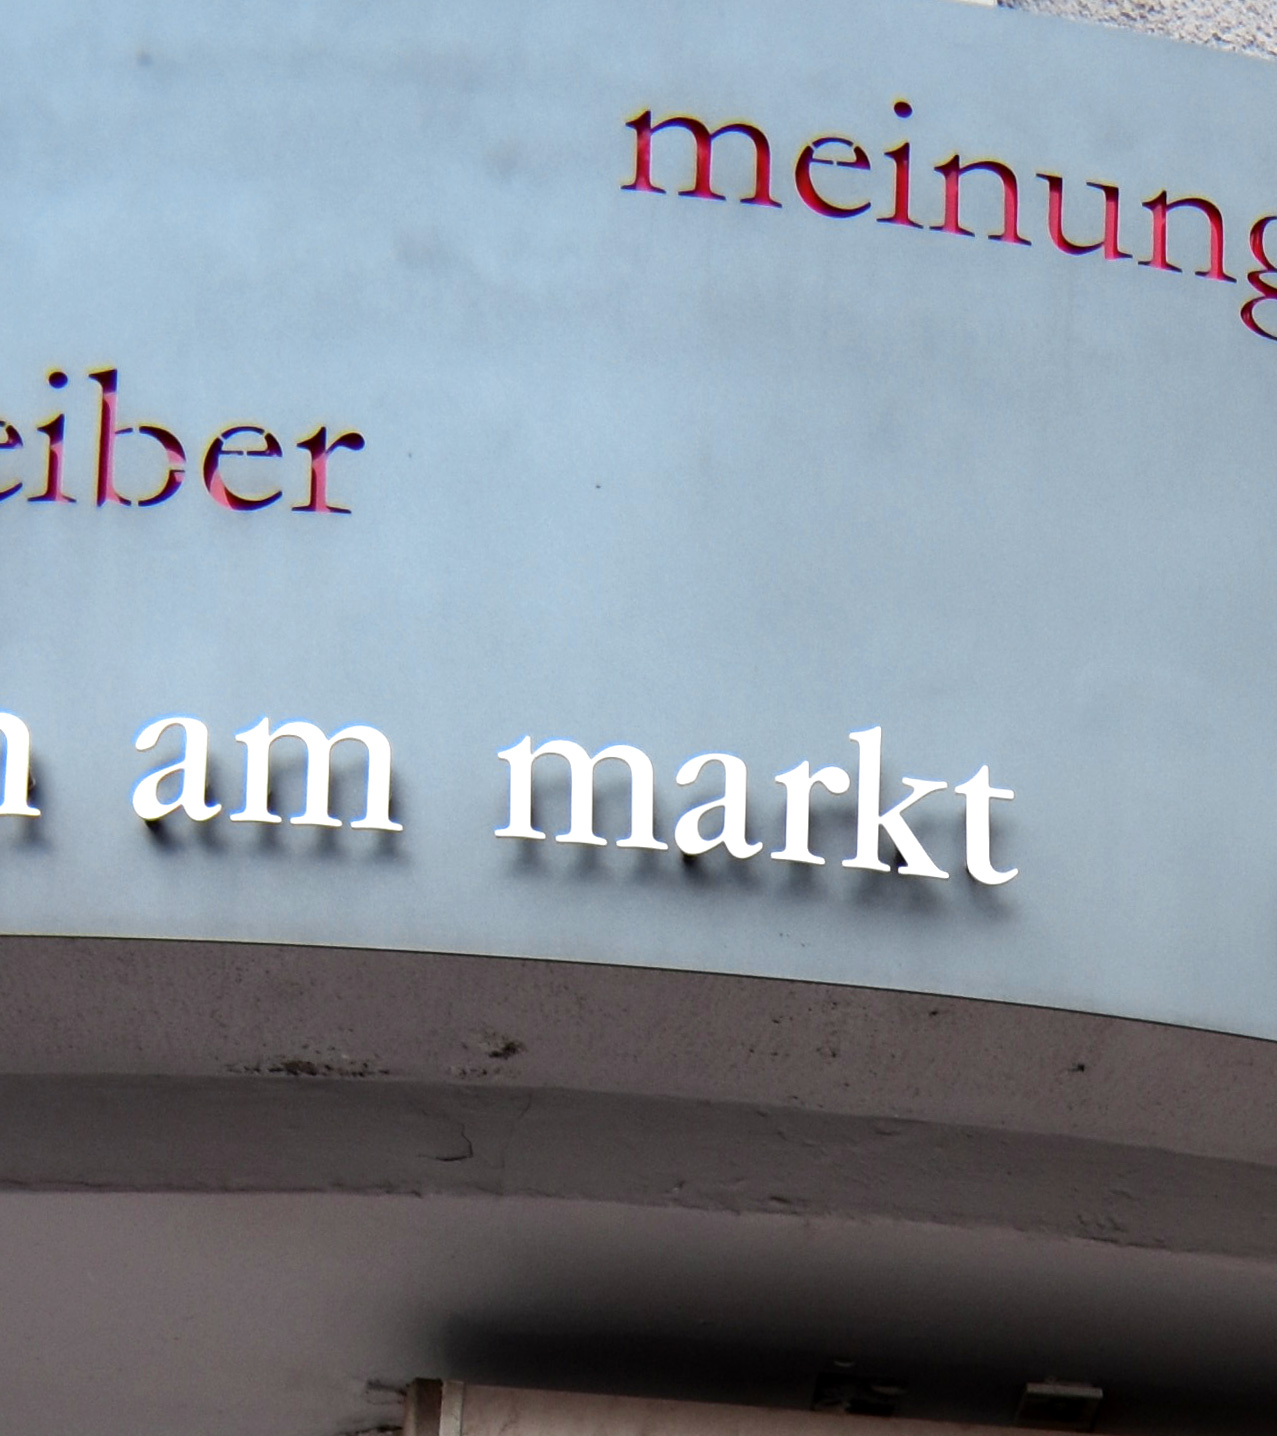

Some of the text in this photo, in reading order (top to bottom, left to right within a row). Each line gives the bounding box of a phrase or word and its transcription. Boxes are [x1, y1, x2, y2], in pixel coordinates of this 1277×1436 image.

[0, 369, 364, 514] iber
[132, 713, 403, 832] am
[495, 725, 1020, 886] markt
